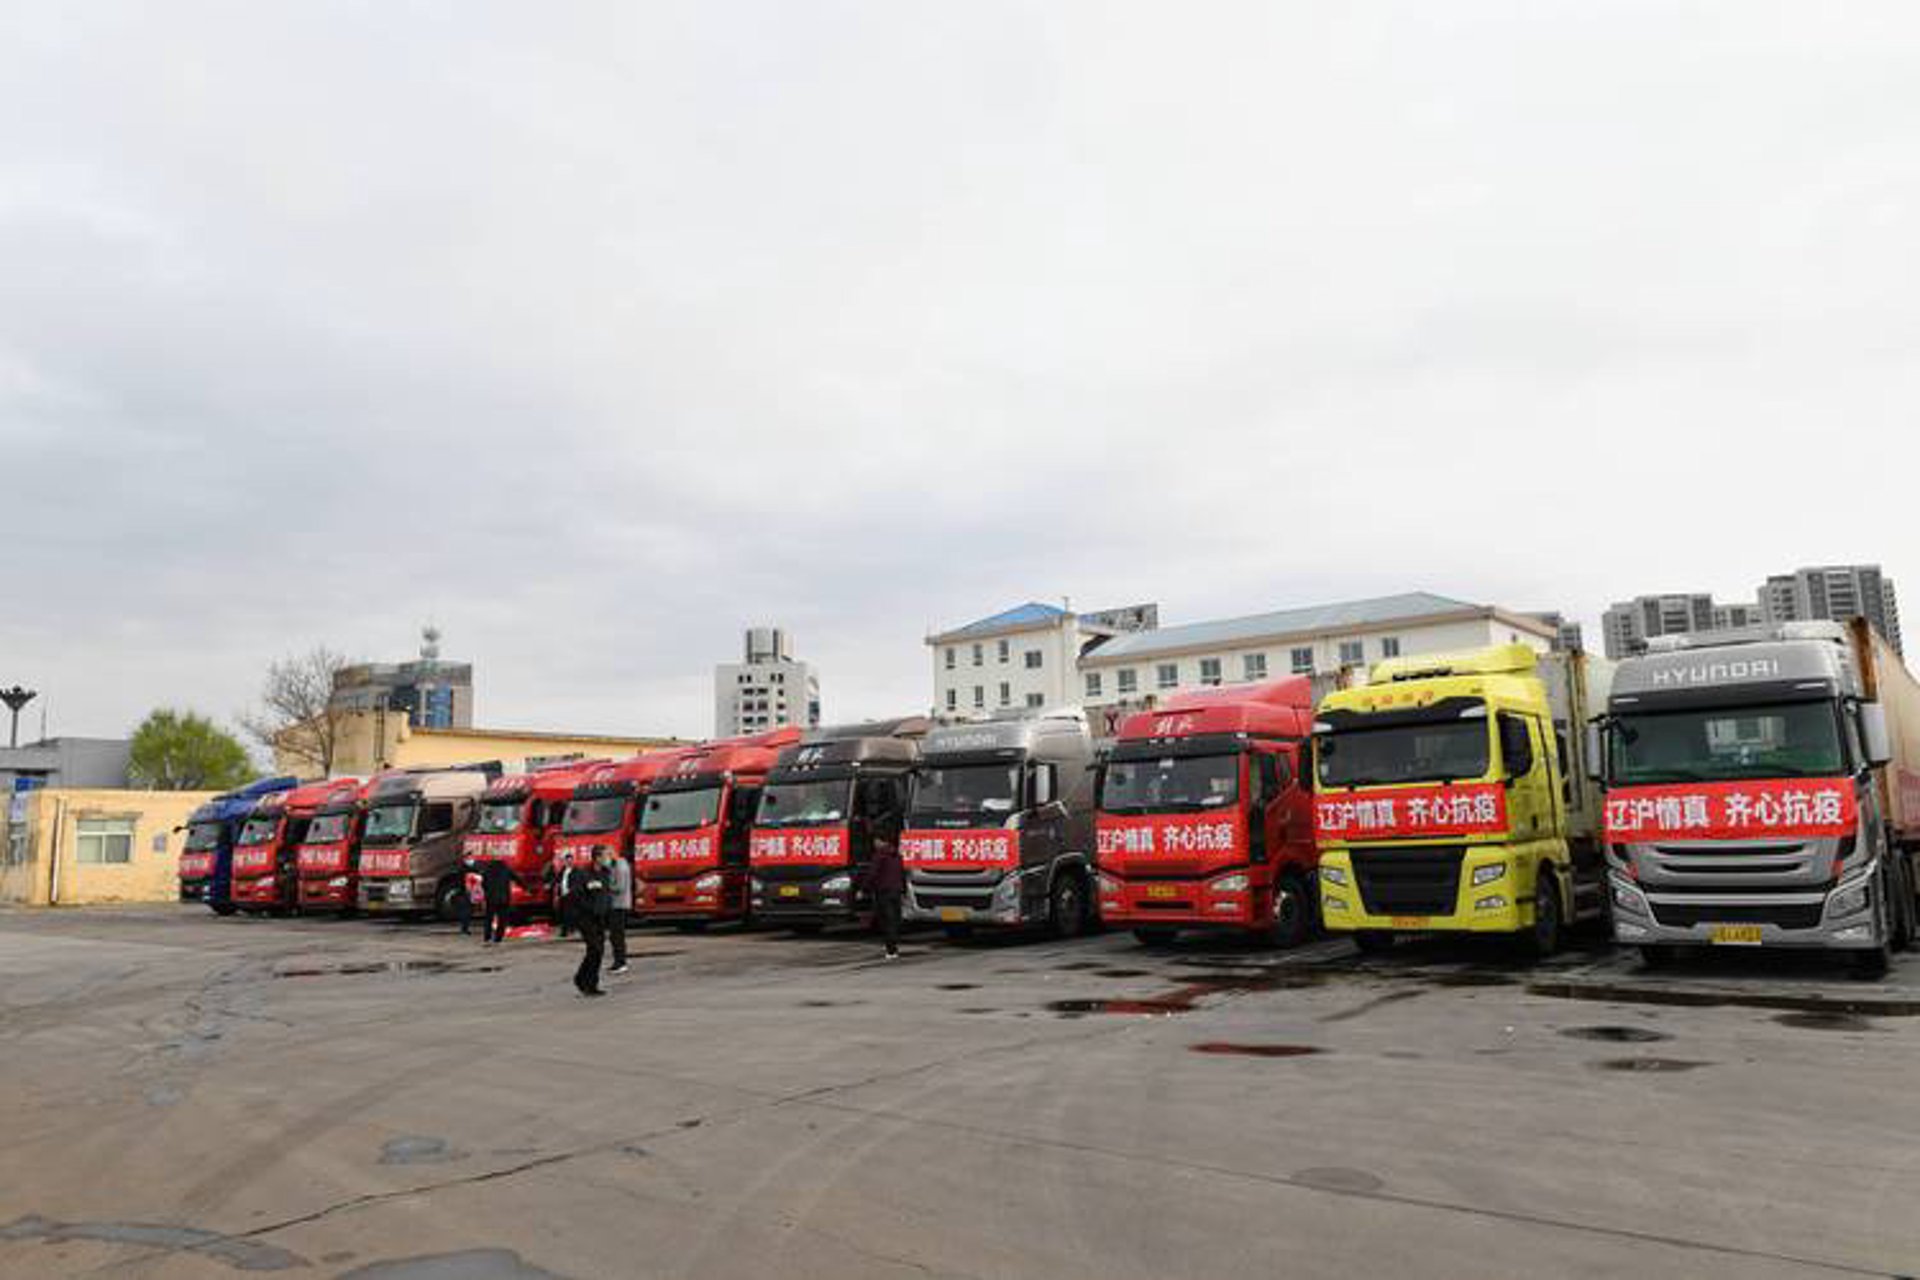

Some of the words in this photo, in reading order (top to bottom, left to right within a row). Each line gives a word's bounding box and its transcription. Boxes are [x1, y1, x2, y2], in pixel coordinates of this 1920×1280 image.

[1652, 659, 1779, 685] HYUNDAI
[1407, 793, 1497, 825] 齐心抗疫
[1605, 796, 1710, 831] 辽沪情真
[1725, 791, 1844, 826] 齐心抗疫
